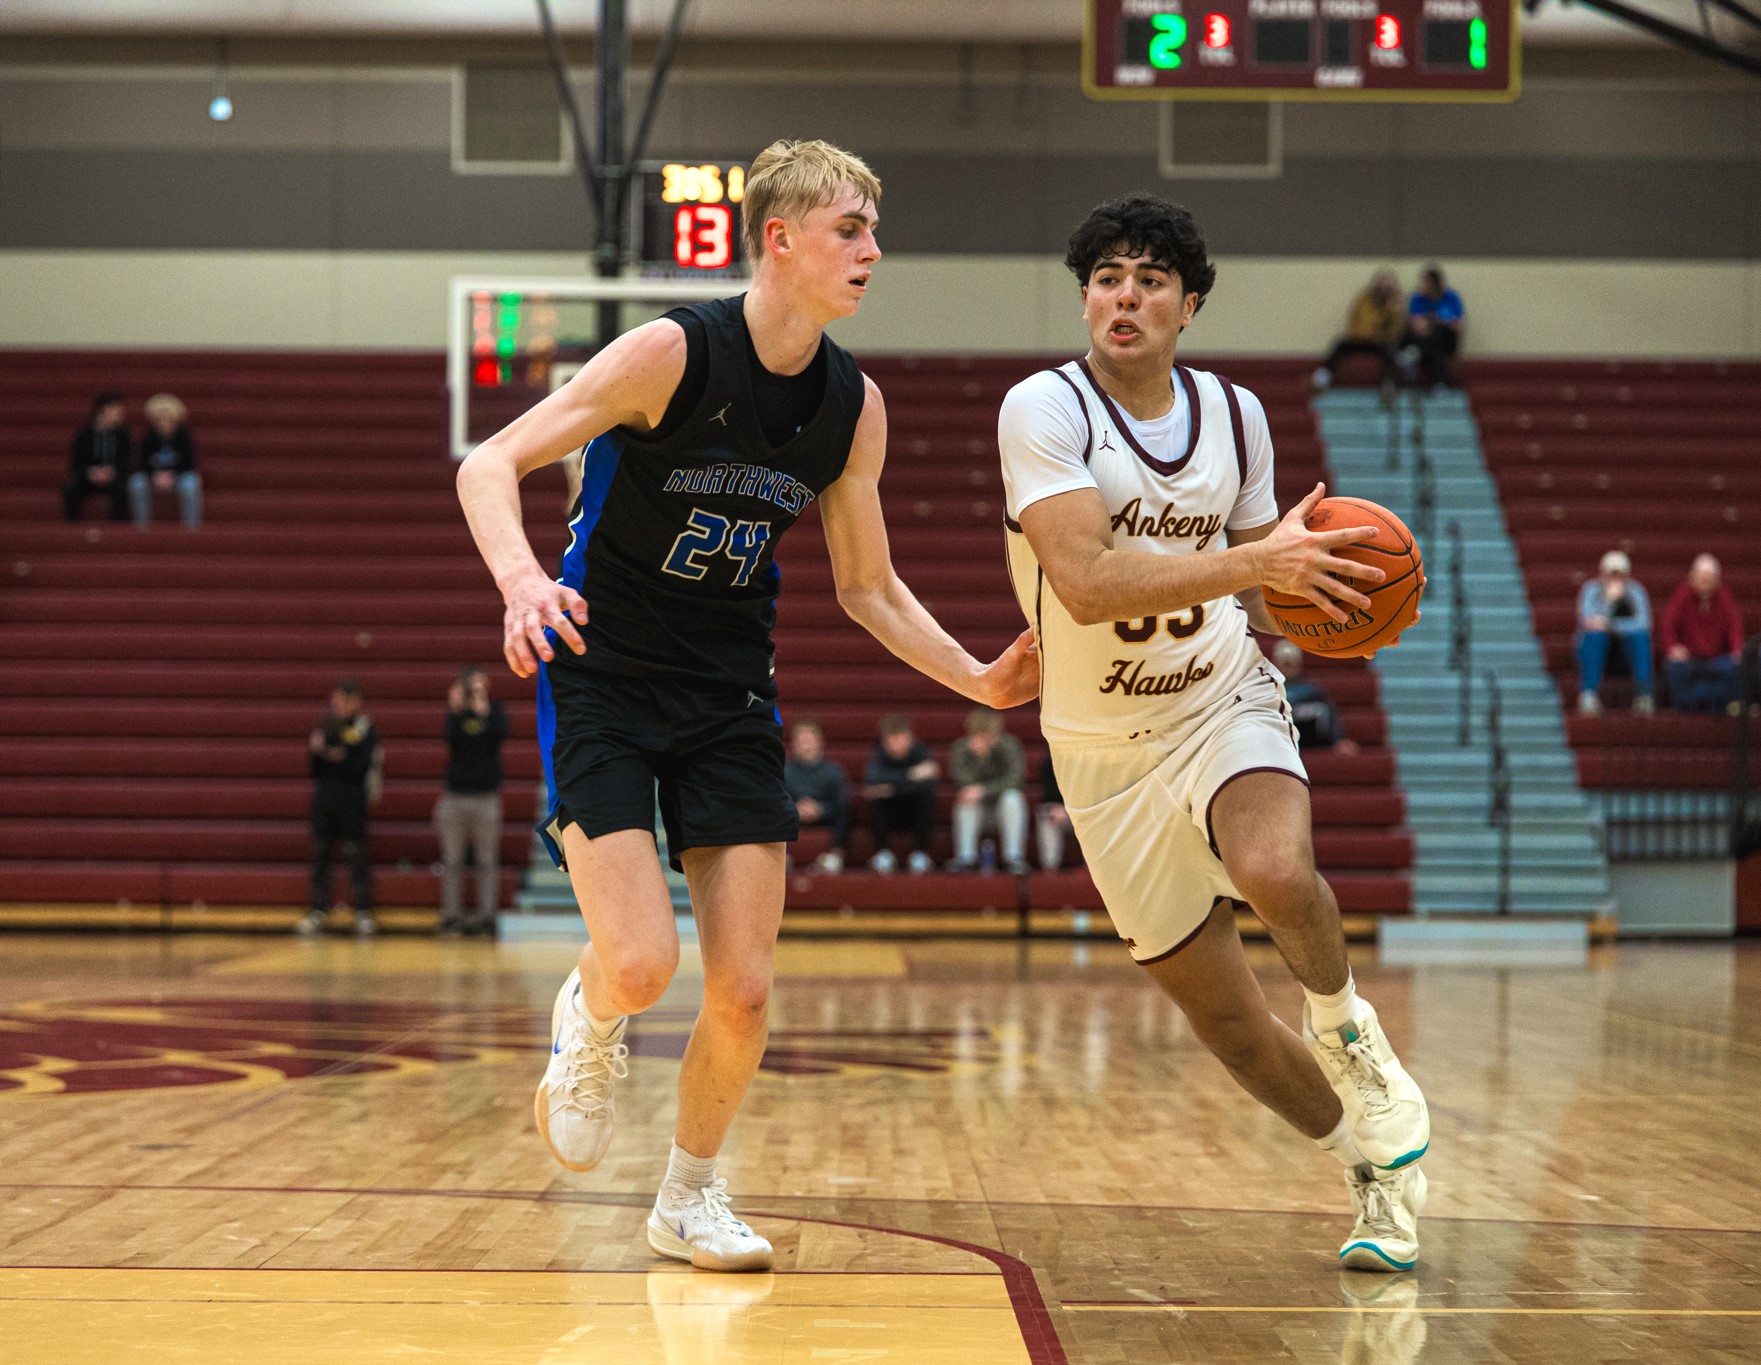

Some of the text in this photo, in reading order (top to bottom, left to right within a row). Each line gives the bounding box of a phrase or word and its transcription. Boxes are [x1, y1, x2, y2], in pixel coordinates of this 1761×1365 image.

[1149, 13, 1188, 70] 2
[1204, 12, 1231, 49] 3
[1375, 13, 1401, 50] 3
[1468, 17, 1488, 70] 1
[674, 203, 733, 269] 13
[663, 463, 816, 517] NORTHWEST
[661, 507, 772, 587] 24
[1110, 497, 1222, 551] Ankeny
[1099, 654, 1215, 696] Hawks
